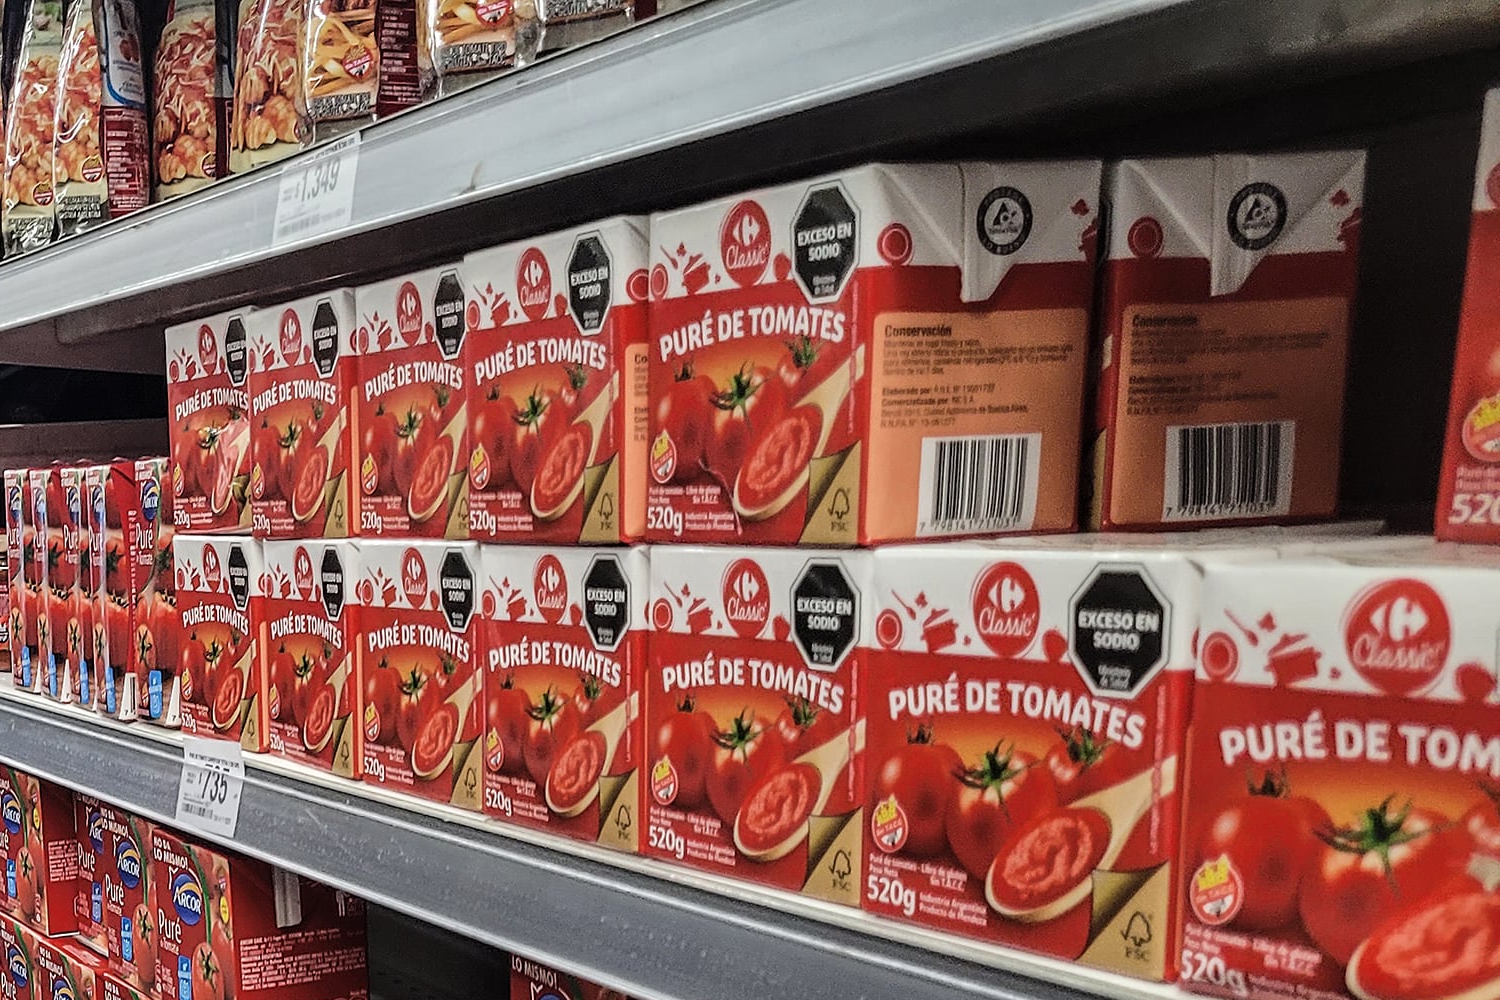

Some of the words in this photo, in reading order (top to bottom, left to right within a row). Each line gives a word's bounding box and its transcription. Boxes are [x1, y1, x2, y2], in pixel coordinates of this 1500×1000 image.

[797, 225, 832, 247] EXCESO
[832, 222, 852, 240] EN
[725, 242, 771, 272] Classic
[807, 242, 839, 262] SODIO
[570, 272, 595, 287] EXCESO
[595, 268, 608, 282] EN
[578, 285, 601, 299] SODIO
[659, 315, 712, 361] PURÉ
[717, 311, 745, 340] DE
[749, 305, 846, 344] TOMATES
[475, 350, 514, 385] PURÉ
[515, 344, 536, 369] DE
[536, 339, 606, 368] TOMATES
[252, 382, 278, 414] PURÉ
[279, 382, 294, 403] DE
[293, 378, 336, 405] TOMATES
[364, 368, 395, 401] PURÉ
[396, 365, 413, 387] DE
[413, 362, 463, 390] TOMATES
[175, 393, 200, 421] PURÉ
[200, 389, 213, 411] DE
[361, 512, 382, 532] 520g
[469, 510, 496, 534] 520g
[647, 506, 683, 535] 520g
[586, 588, 612, 602] EXCESO
[612, 590, 625, 603] EN
[594, 602, 617, 616] SODIO
[726, 597, 766, 622] Classic
[796, 599, 833, 615] EXCESO
[835, 600, 852, 615] EN
[182, 602, 204, 629] PURÉ
[205, 602, 215, 622] DE
[215, 606, 249, 636] TOMATES
[270, 611, 294, 640] PURÉ
[294, 613, 307, 633] DE
[306, 615, 342, 650] TOMATES
[807, 614, 840, 631] SODIO
[977, 605, 1032, 638] Classic
[1077, 610, 1131, 631] EXCESO
[1134, 612, 1158, 632] EN
[368, 625, 400, 653] PURÉ
[401, 625, 418, 646] DE
[418, 625, 470, 664] TOMATES
[1093, 630, 1140, 650] SODIO
[1353, 635, 1439, 673] Classic
[489, 641, 529, 672] PURÉ
[530, 643, 551, 666] DE
[553, 643, 621, 688] TOMATES
[662, 658, 715, 692] PURÉ
[719, 657, 745, 687] DE
[748, 658, 844, 715] TOMATES
[889, 673, 960, 720] PURÉ
[965, 680, 1000, 713] DE
[1002, 685, 1147, 749] TOMATES
[1219, 708, 1326, 765] PURÉ
[1334, 722, 1388, 761] DE
[363, 757, 385, 782] 520g
[486, 793, 512, 817] 520g
[648, 827, 686, 860] 520g
[172, 887, 201, 913] ARCOR
[866, 875, 916, 917] 520g
[158, 909, 182, 944] Puré
[1180, 948, 1249, 997] 520g
